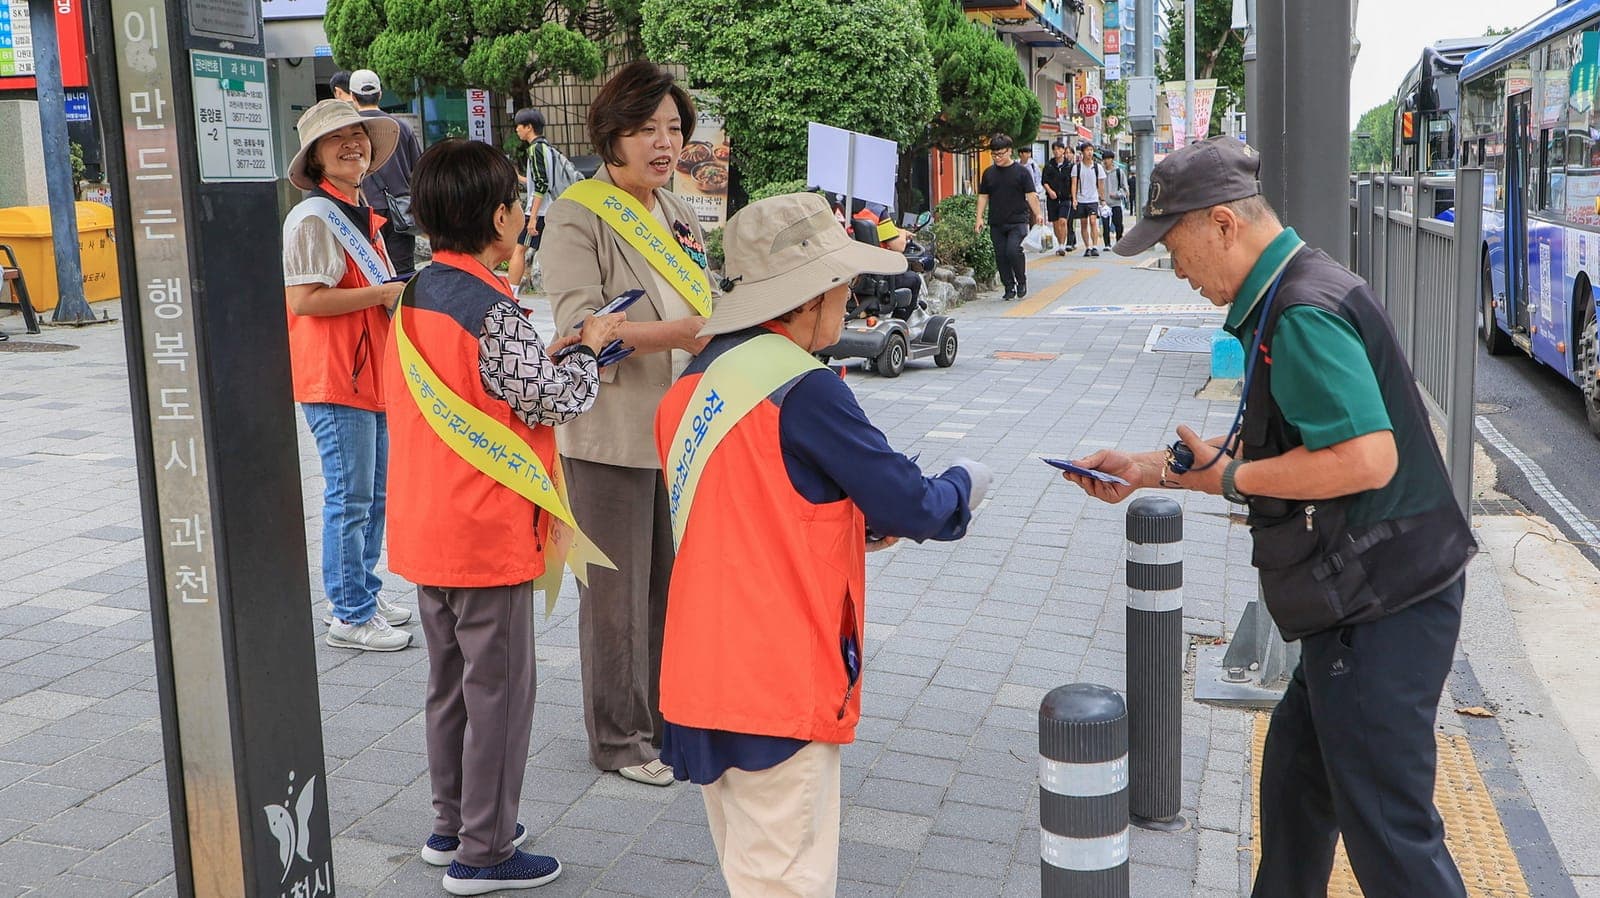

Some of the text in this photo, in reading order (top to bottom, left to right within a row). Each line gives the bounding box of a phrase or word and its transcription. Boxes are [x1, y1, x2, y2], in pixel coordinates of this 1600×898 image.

[200, 108, 223, 123] 중앙로
[207, 128, 218, 140] -2
[236, 159, 266, 169] 3677-2222
[147, 277, 197, 477] 행복도시
[170, 513, 209, 603] 과천
[281, 861, 331, 898] 천시
